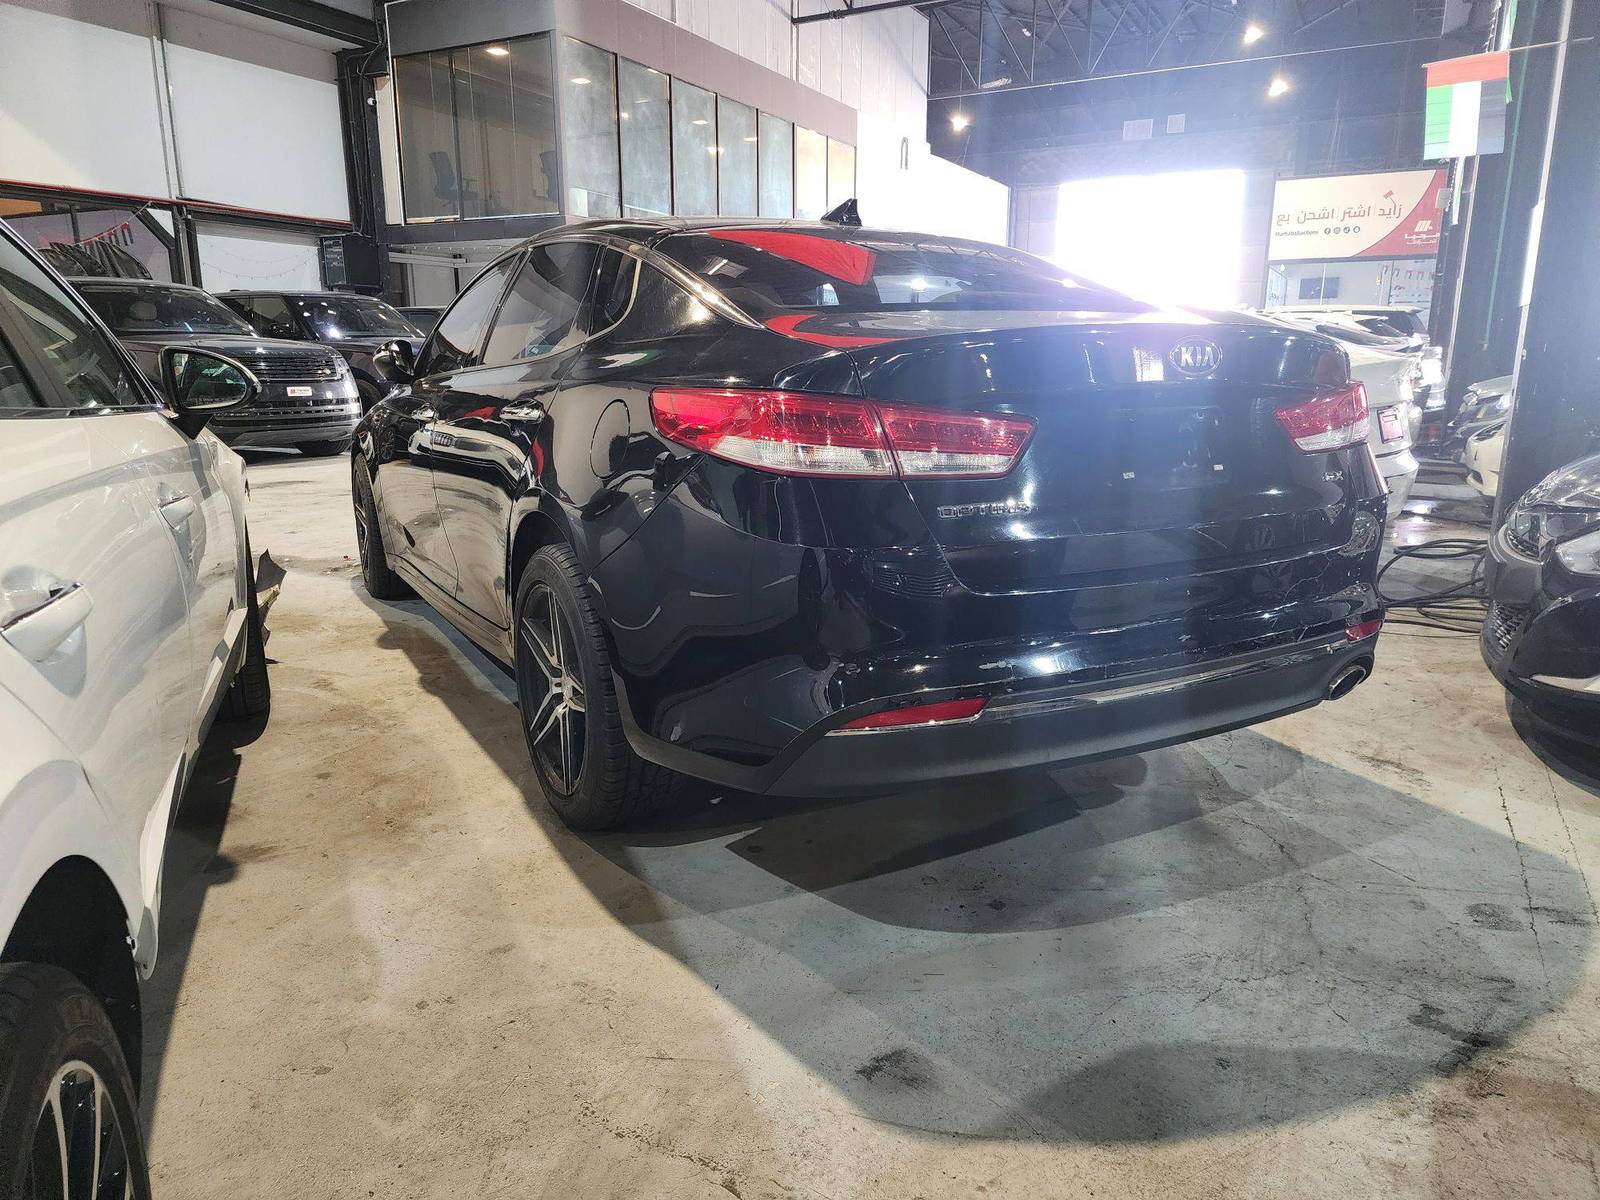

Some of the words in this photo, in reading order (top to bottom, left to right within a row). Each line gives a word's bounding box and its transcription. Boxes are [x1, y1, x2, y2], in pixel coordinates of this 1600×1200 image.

[1296, 207, 1335, 225] اشحن
[1180, 345, 1214, 368] KIA
[937, 501, 1031, 519] OPTIMA
